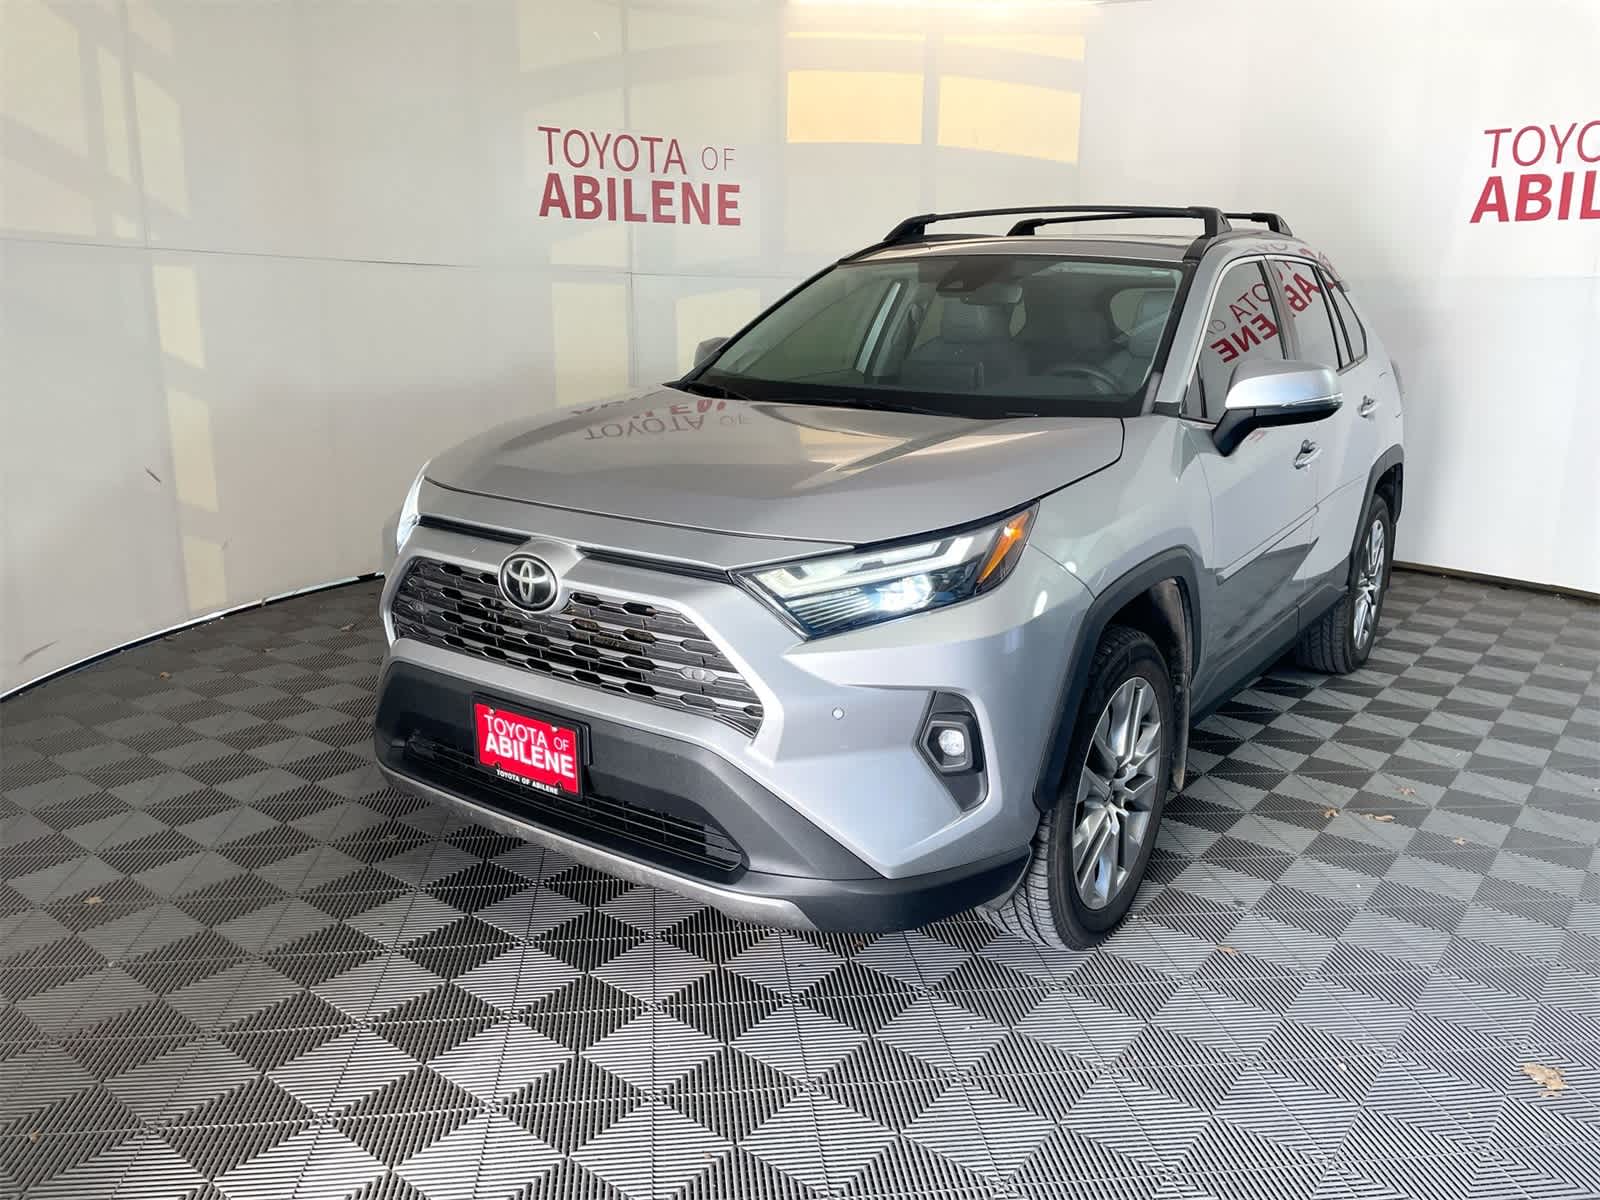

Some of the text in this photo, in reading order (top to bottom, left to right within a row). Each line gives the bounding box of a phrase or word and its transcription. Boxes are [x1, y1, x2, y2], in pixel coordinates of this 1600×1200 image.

[537, 126, 736, 175] TOYOTA OF
[1484, 120, 1600, 168] TOYO
[539, 172, 741, 226] ABILENE
[1469, 170, 1600, 224] ABIL
[483, 714, 569, 752] TOYOTA OF
[485, 732, 575, 778] ABILENE
[496, 769, 520, 783] TOYOTA
[531, 780, 559, 795] ABILENE
